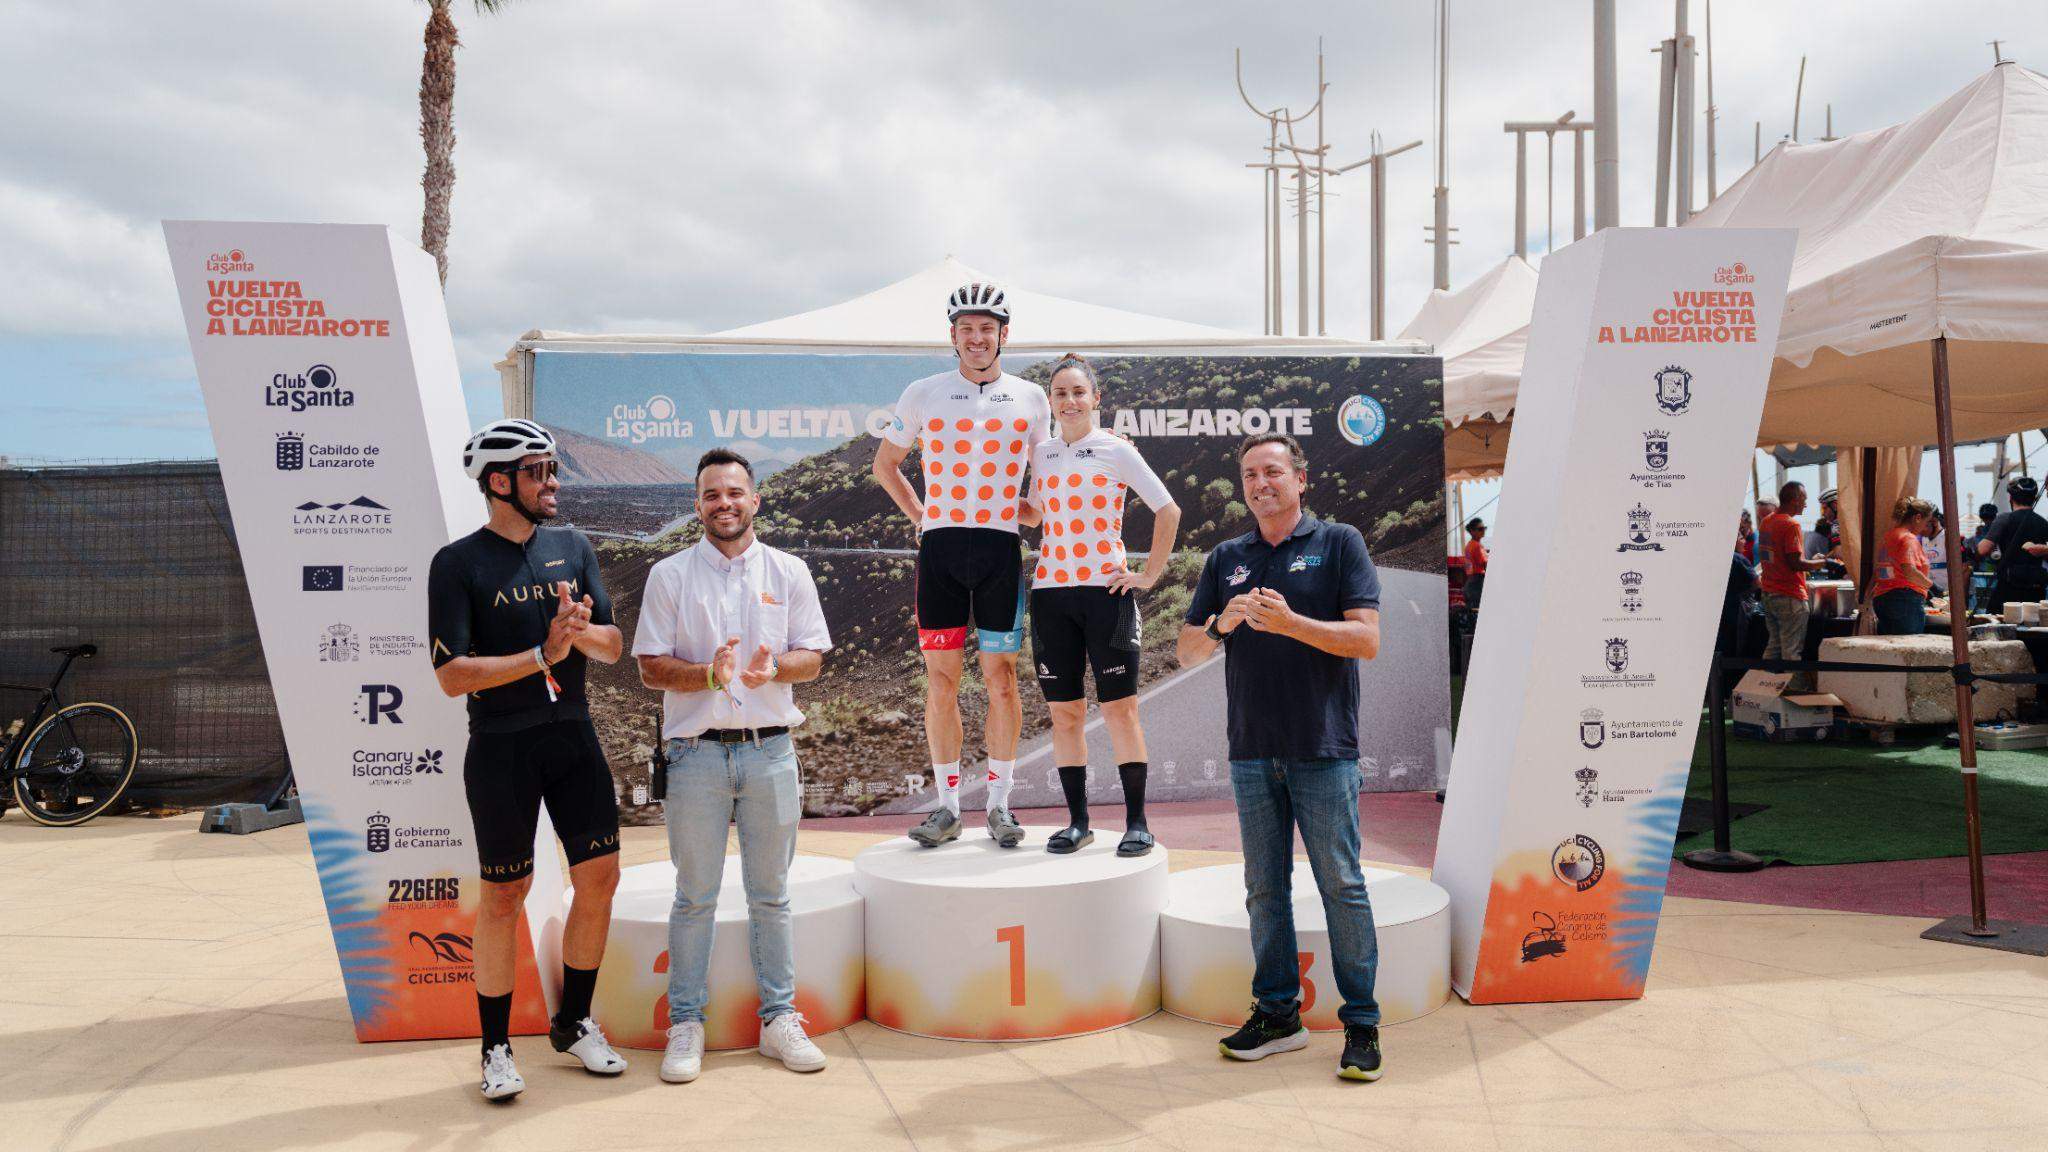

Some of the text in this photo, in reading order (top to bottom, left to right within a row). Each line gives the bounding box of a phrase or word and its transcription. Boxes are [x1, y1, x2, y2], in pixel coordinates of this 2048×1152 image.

[210, 252, 229, 262] Club
[1717, 267, 1733, 275] Club
[207, 280, 303, 298] VUELTA
[1673, 291, 1755, 307] VUELTA
[206, 300, 326, 318] CICLISTA
[1653, 309, 1756, 325] CICLISTA
[206, 319, 390, 337] A LANZAROTE
[1869, 312, 1908, 331] MASTERTENT
[1597, 326, 1757, 344] A LANZAROTE
[273, 373, 307, 389] Club
[613, 404, 647, 420] Club
[709, 409, 855, 438] VUELTA
[309, 445, 380, 455] Cabildo de
[309, 457, 375, 468] Lanzarote
[1630, 473, 1686, 482] Ayuntamiento
[293, 514, 392, 524] LANZAROTE
[1611, 720, 1684, 729] Ayuntamiento de
[1611, 728, 1677, 739] San Bartolomé
[352, 750, 413, 766] Canary
[352, 763, 413, 777] Islands
[394, 826, 450, 837] Gobierno
[394, 838, 463, 848] de Canarias
[1560, 838, 1575, 847] UCI
[1577, 837, 1603, 863] CYCLING
[481, 857, 533, 875] URUM
[388, 877, 460, 902] 226ERS
[997, 925, 1026, 1007] 1
